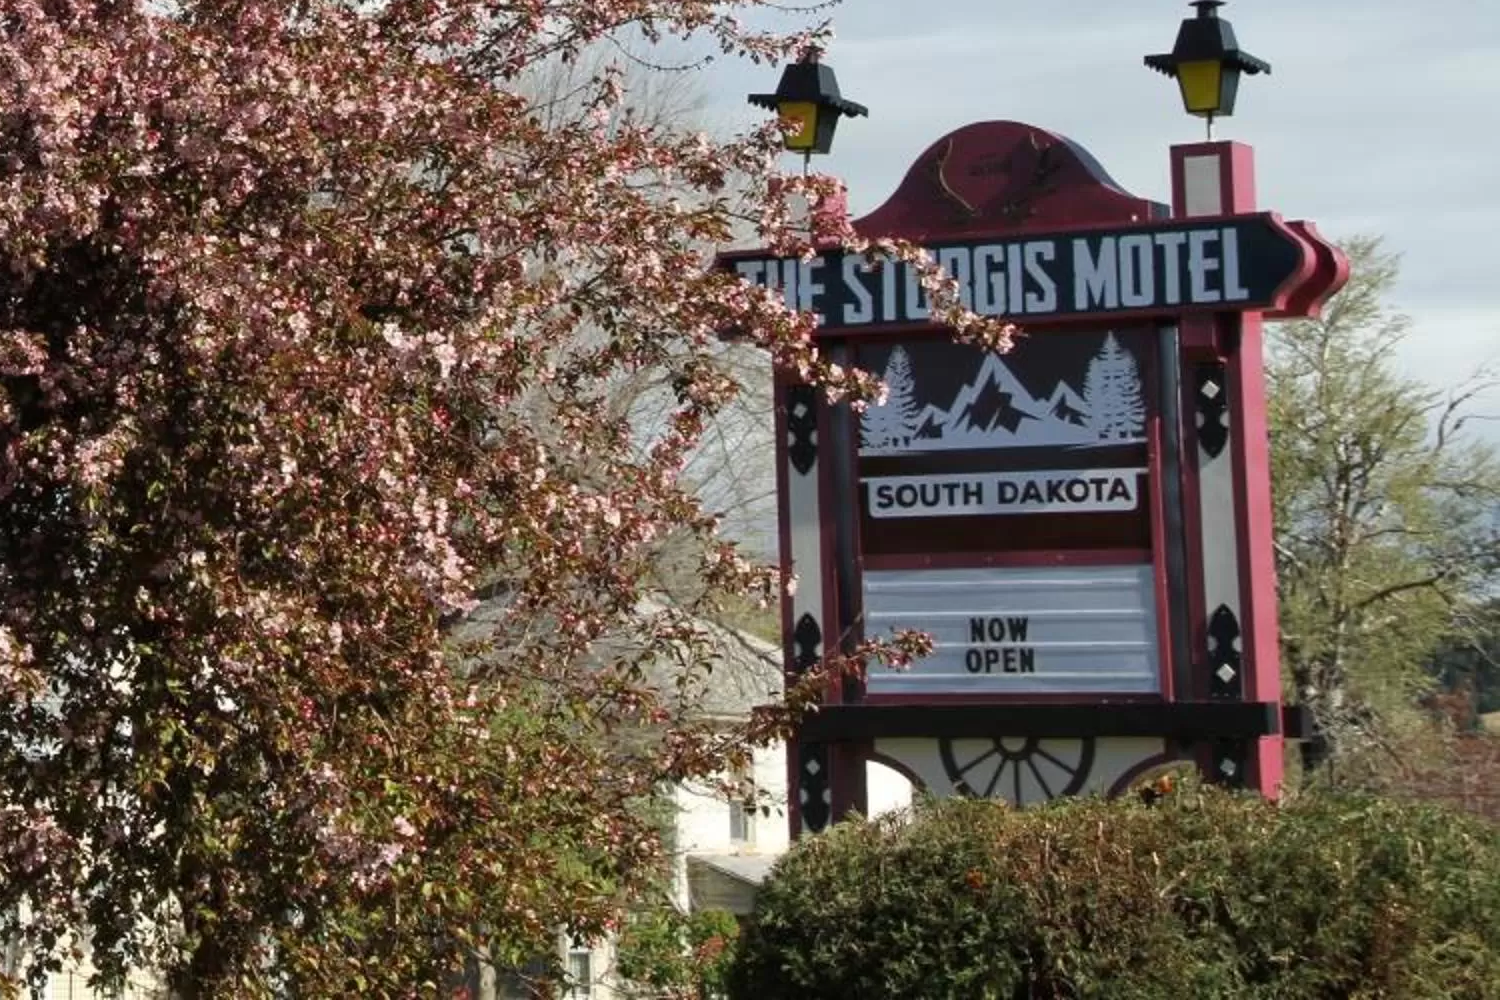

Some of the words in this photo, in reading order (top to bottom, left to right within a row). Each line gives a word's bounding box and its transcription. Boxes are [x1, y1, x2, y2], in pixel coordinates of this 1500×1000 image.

[1073, 227, 1249, 311] MOTEL
[876, 482, 984, 509] SOUTH
[997, 477, 1132, 505] DAKOTA
[970, 617, 1028, 642] NOW
[965, 648, 1035, 673] OPEN
